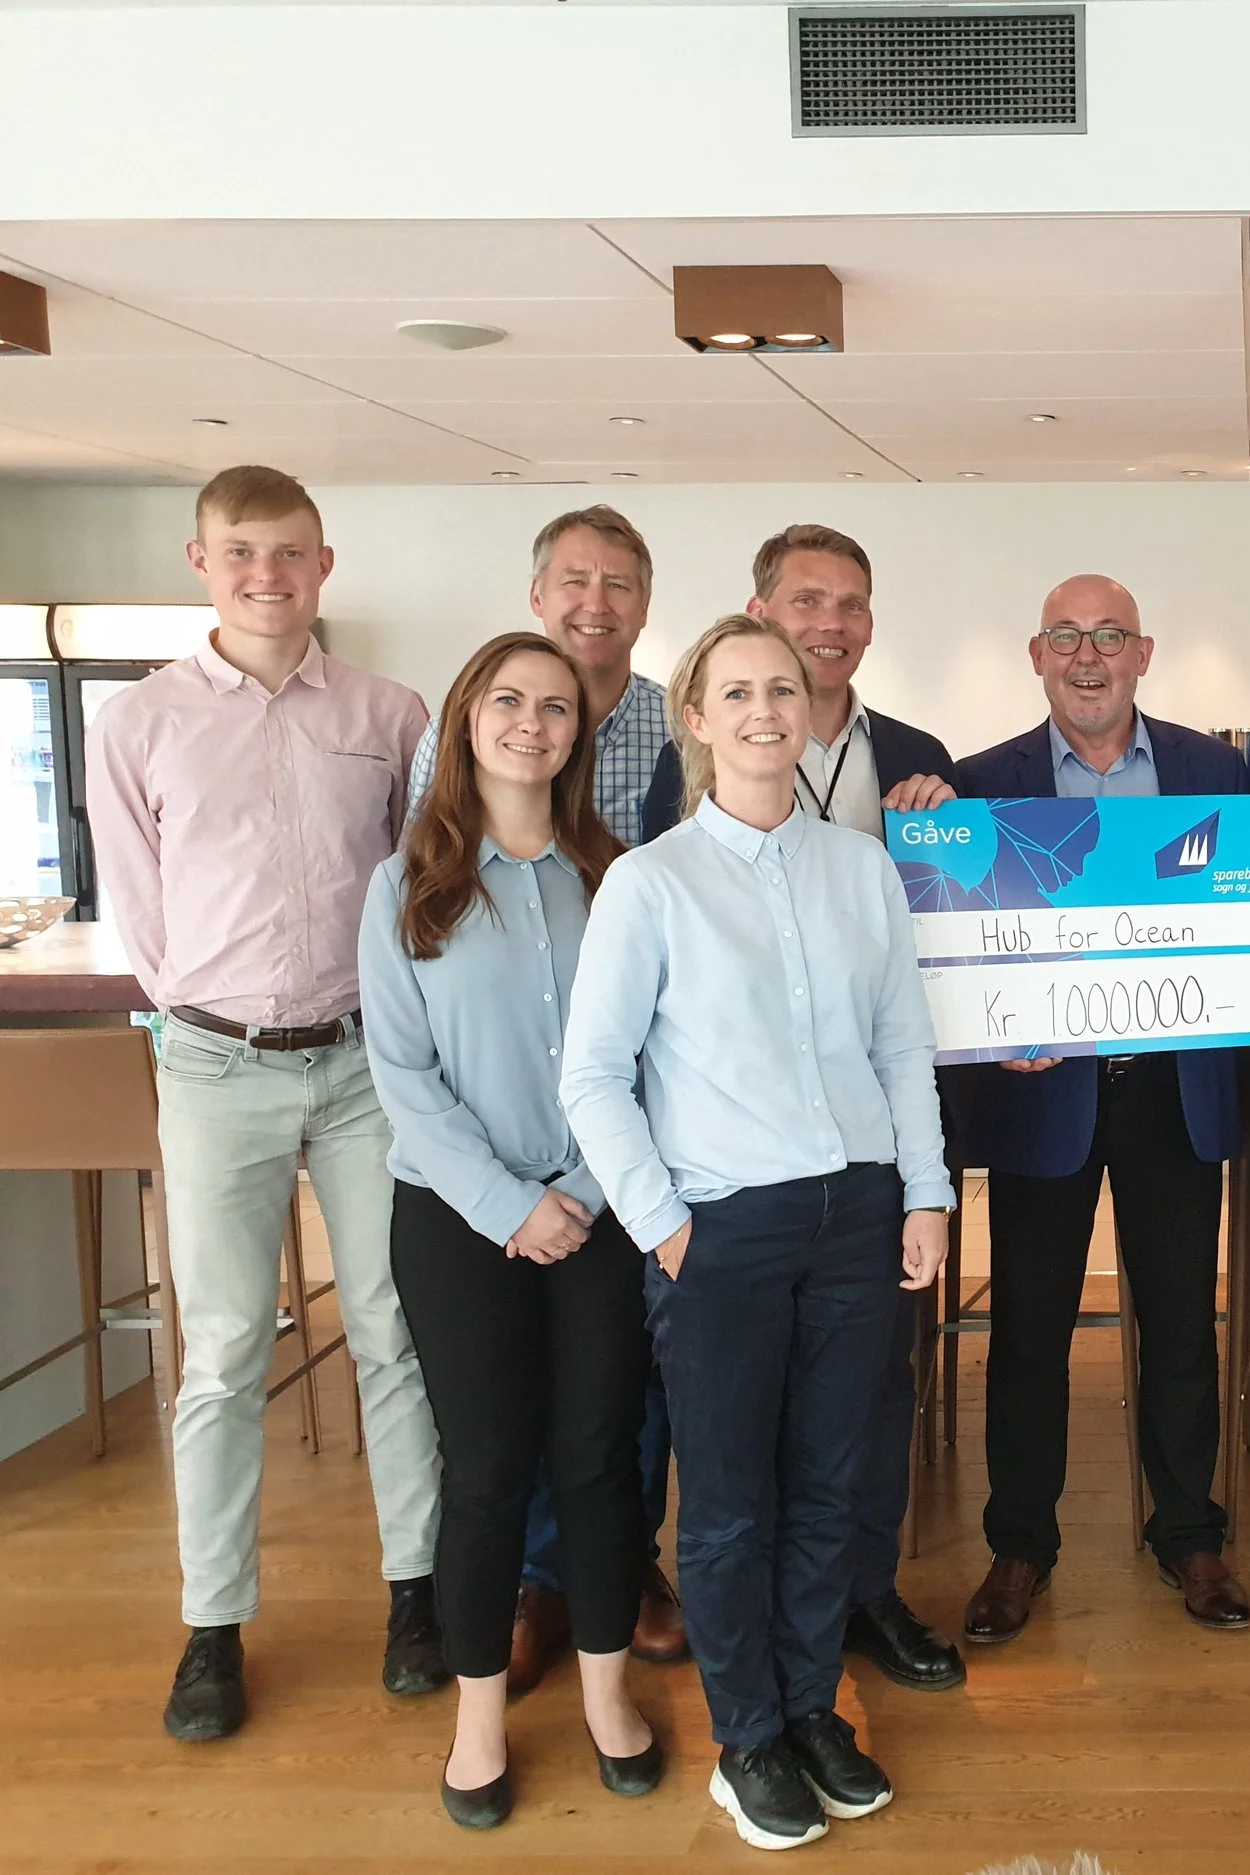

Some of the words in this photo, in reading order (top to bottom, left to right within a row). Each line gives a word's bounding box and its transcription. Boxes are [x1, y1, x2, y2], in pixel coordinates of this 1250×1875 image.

[902, 819, 972, 845] Gåve
[1212, 883, 1234, 894] sogn
[1235, 884, 1247, 893] og
[981, 914, 1032, 952] Hub
[1055, 914, 1099, 950] for
[1114, 911, 1195, 946] Ocean
